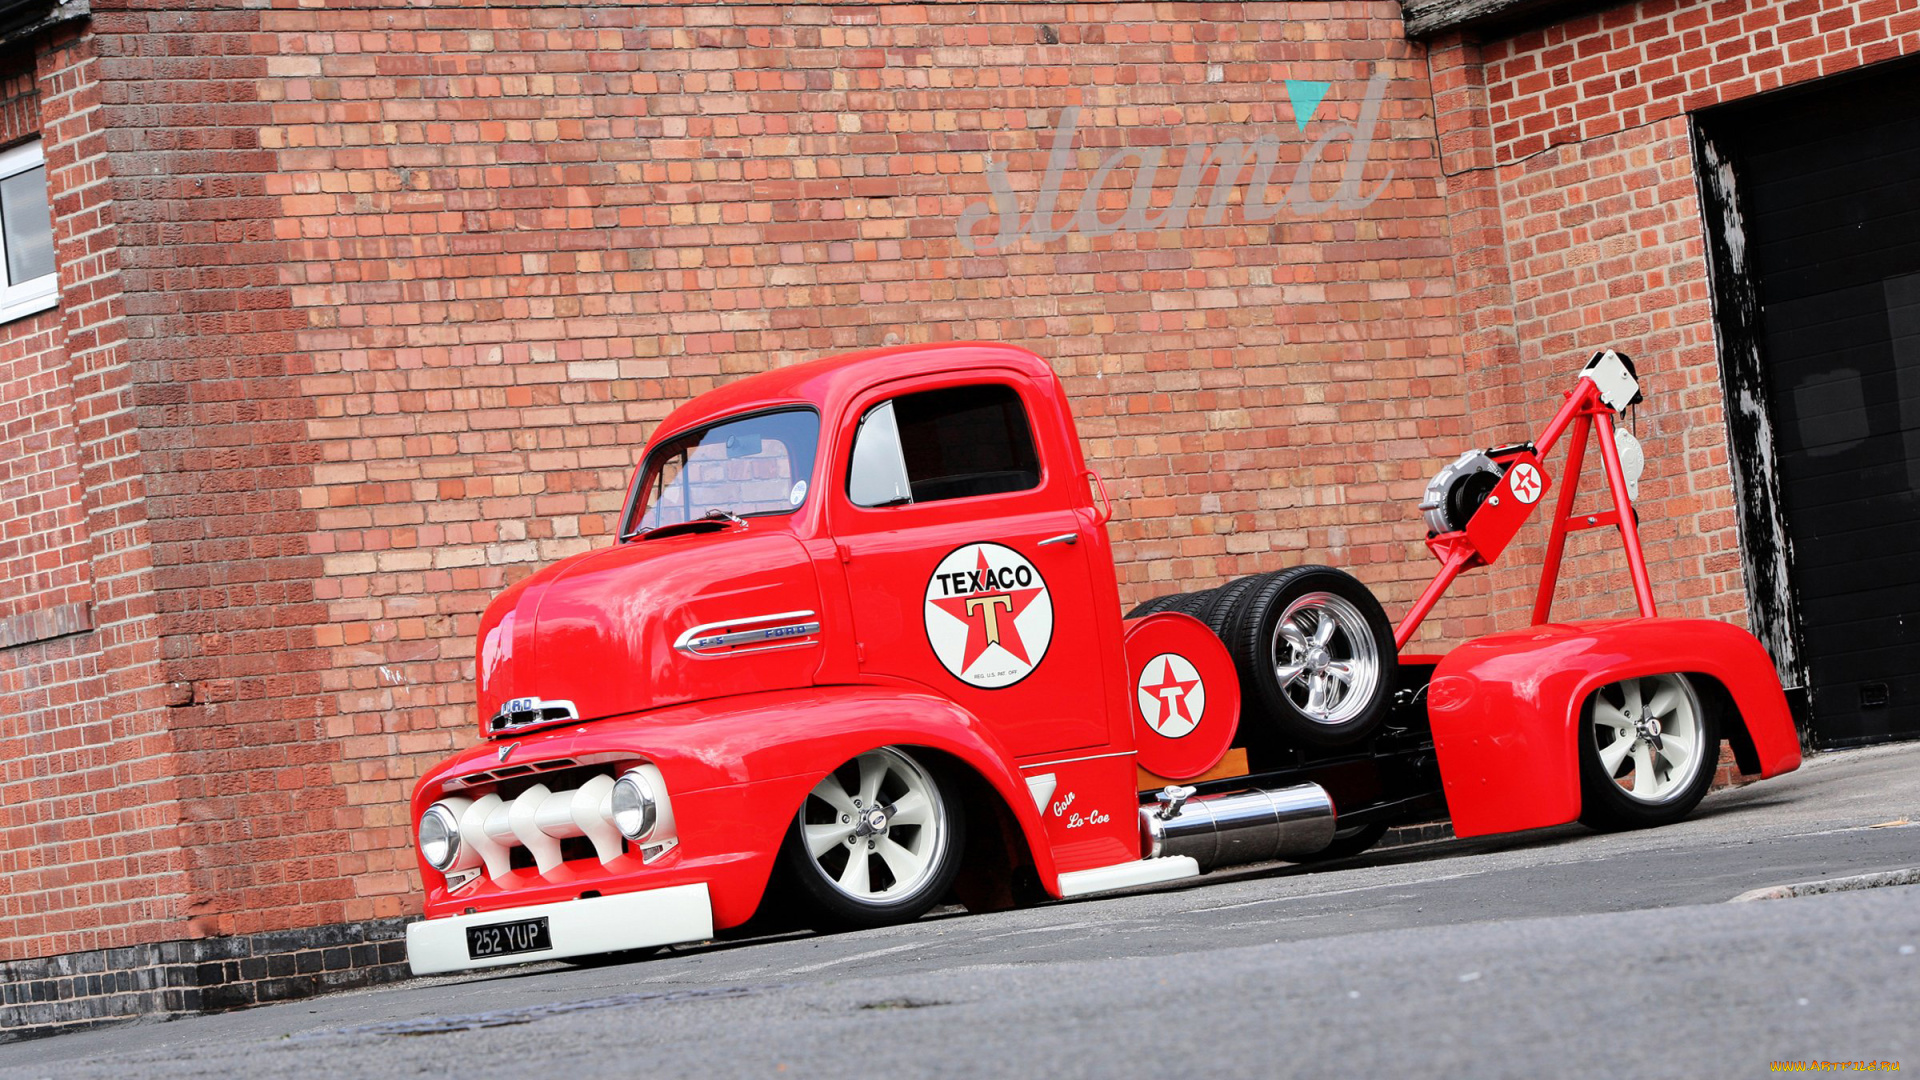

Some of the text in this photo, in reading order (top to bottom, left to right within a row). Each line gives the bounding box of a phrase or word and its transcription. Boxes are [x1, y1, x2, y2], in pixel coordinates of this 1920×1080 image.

[936, 564, 1033, 596] TEXACO
[764, 625, 808, 639] FORD
[965, 593, 1013, 647] T
[1053, 791, 1076, 817] Goin
[1066, 809, 1111, 829] Lo-Coe
[474, 923, 539, 955] 252 YUP
